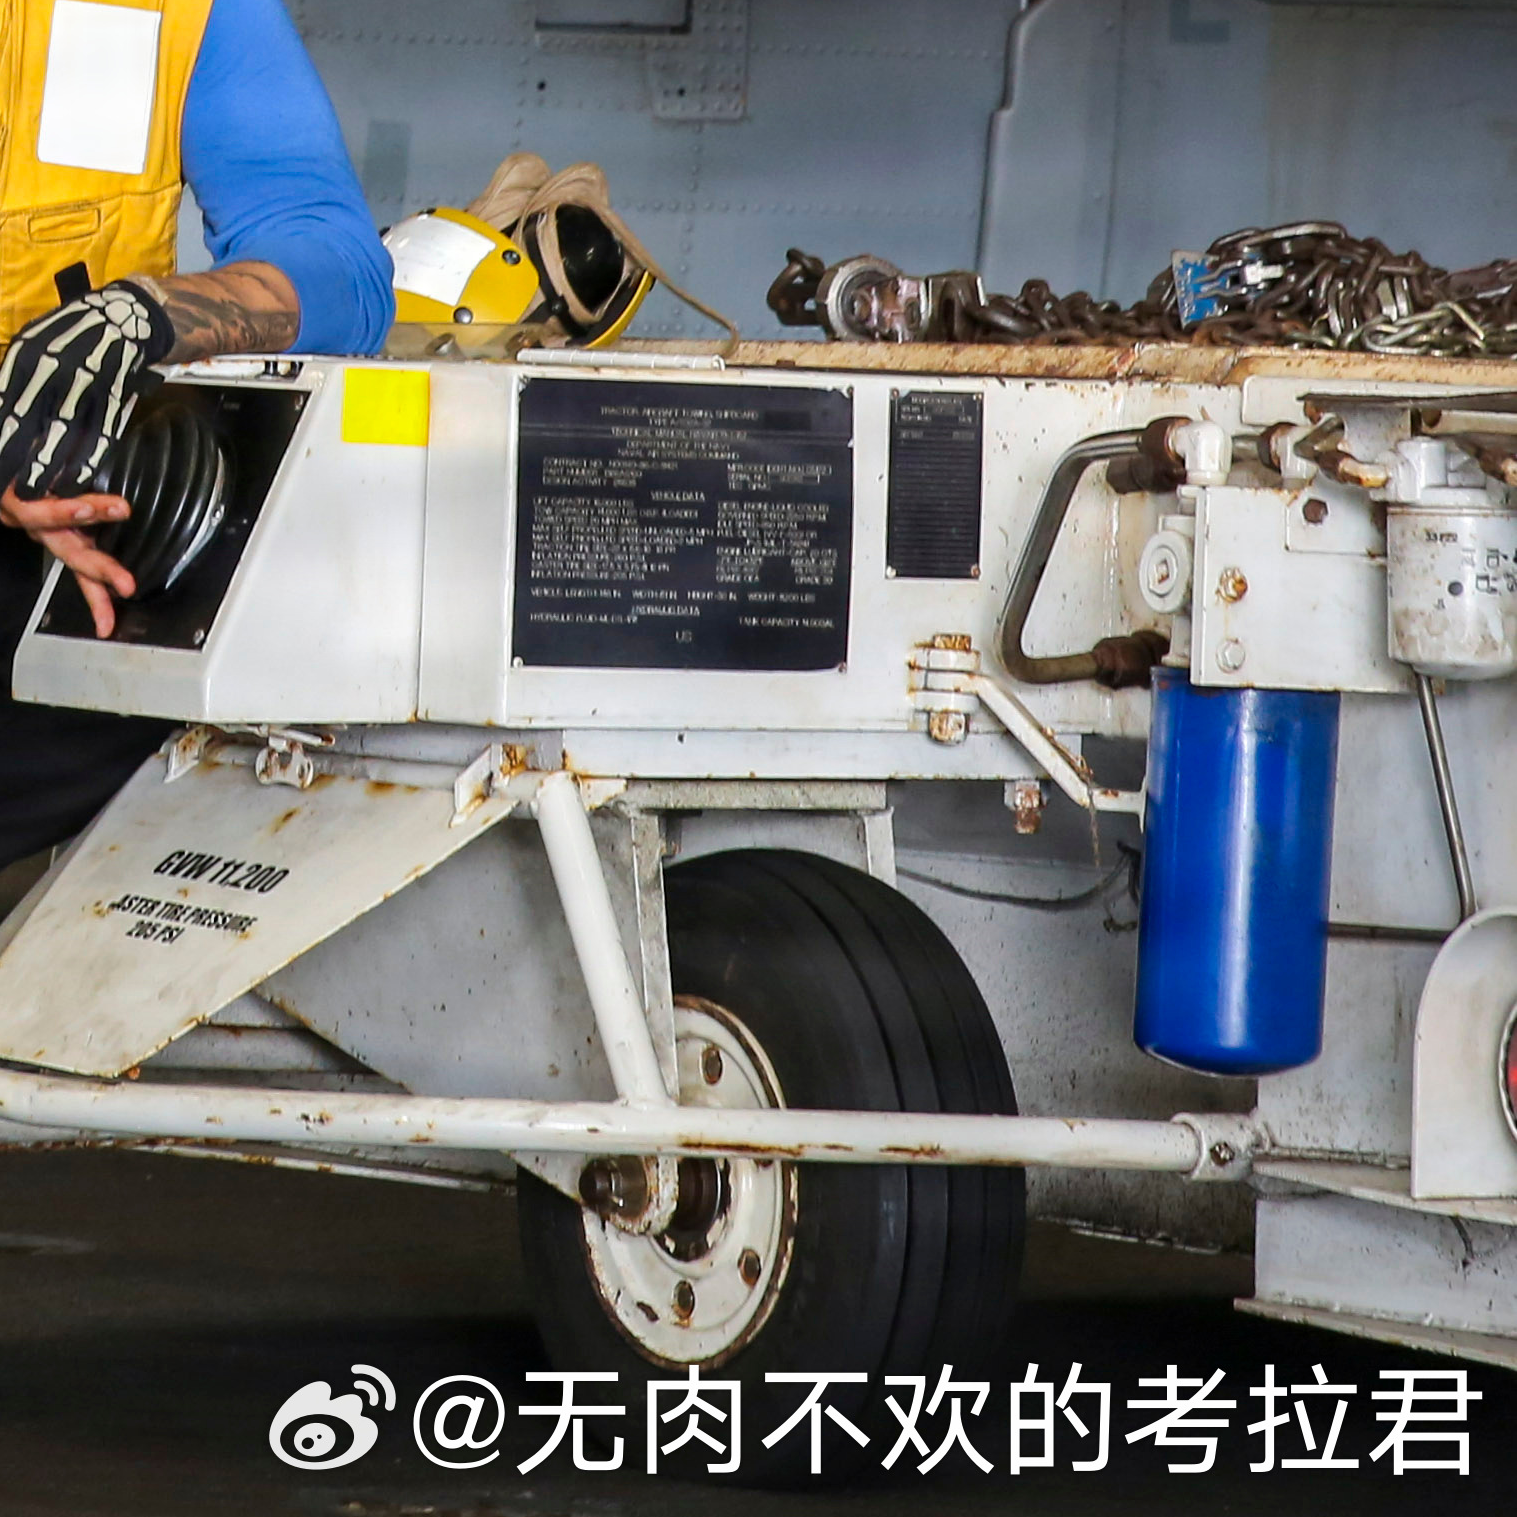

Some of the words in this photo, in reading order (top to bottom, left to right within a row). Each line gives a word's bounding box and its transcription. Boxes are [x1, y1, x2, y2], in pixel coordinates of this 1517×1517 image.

[153, 849, 221, 882] GVW
[209, 858, 290, 895] 11,200
[109, 893, 161, 918] ASTER
[156, 901, 192, 922] TIRE
[184, 907, 258, 933] PRESSURE
[154, 925, 185, 944] PSI
